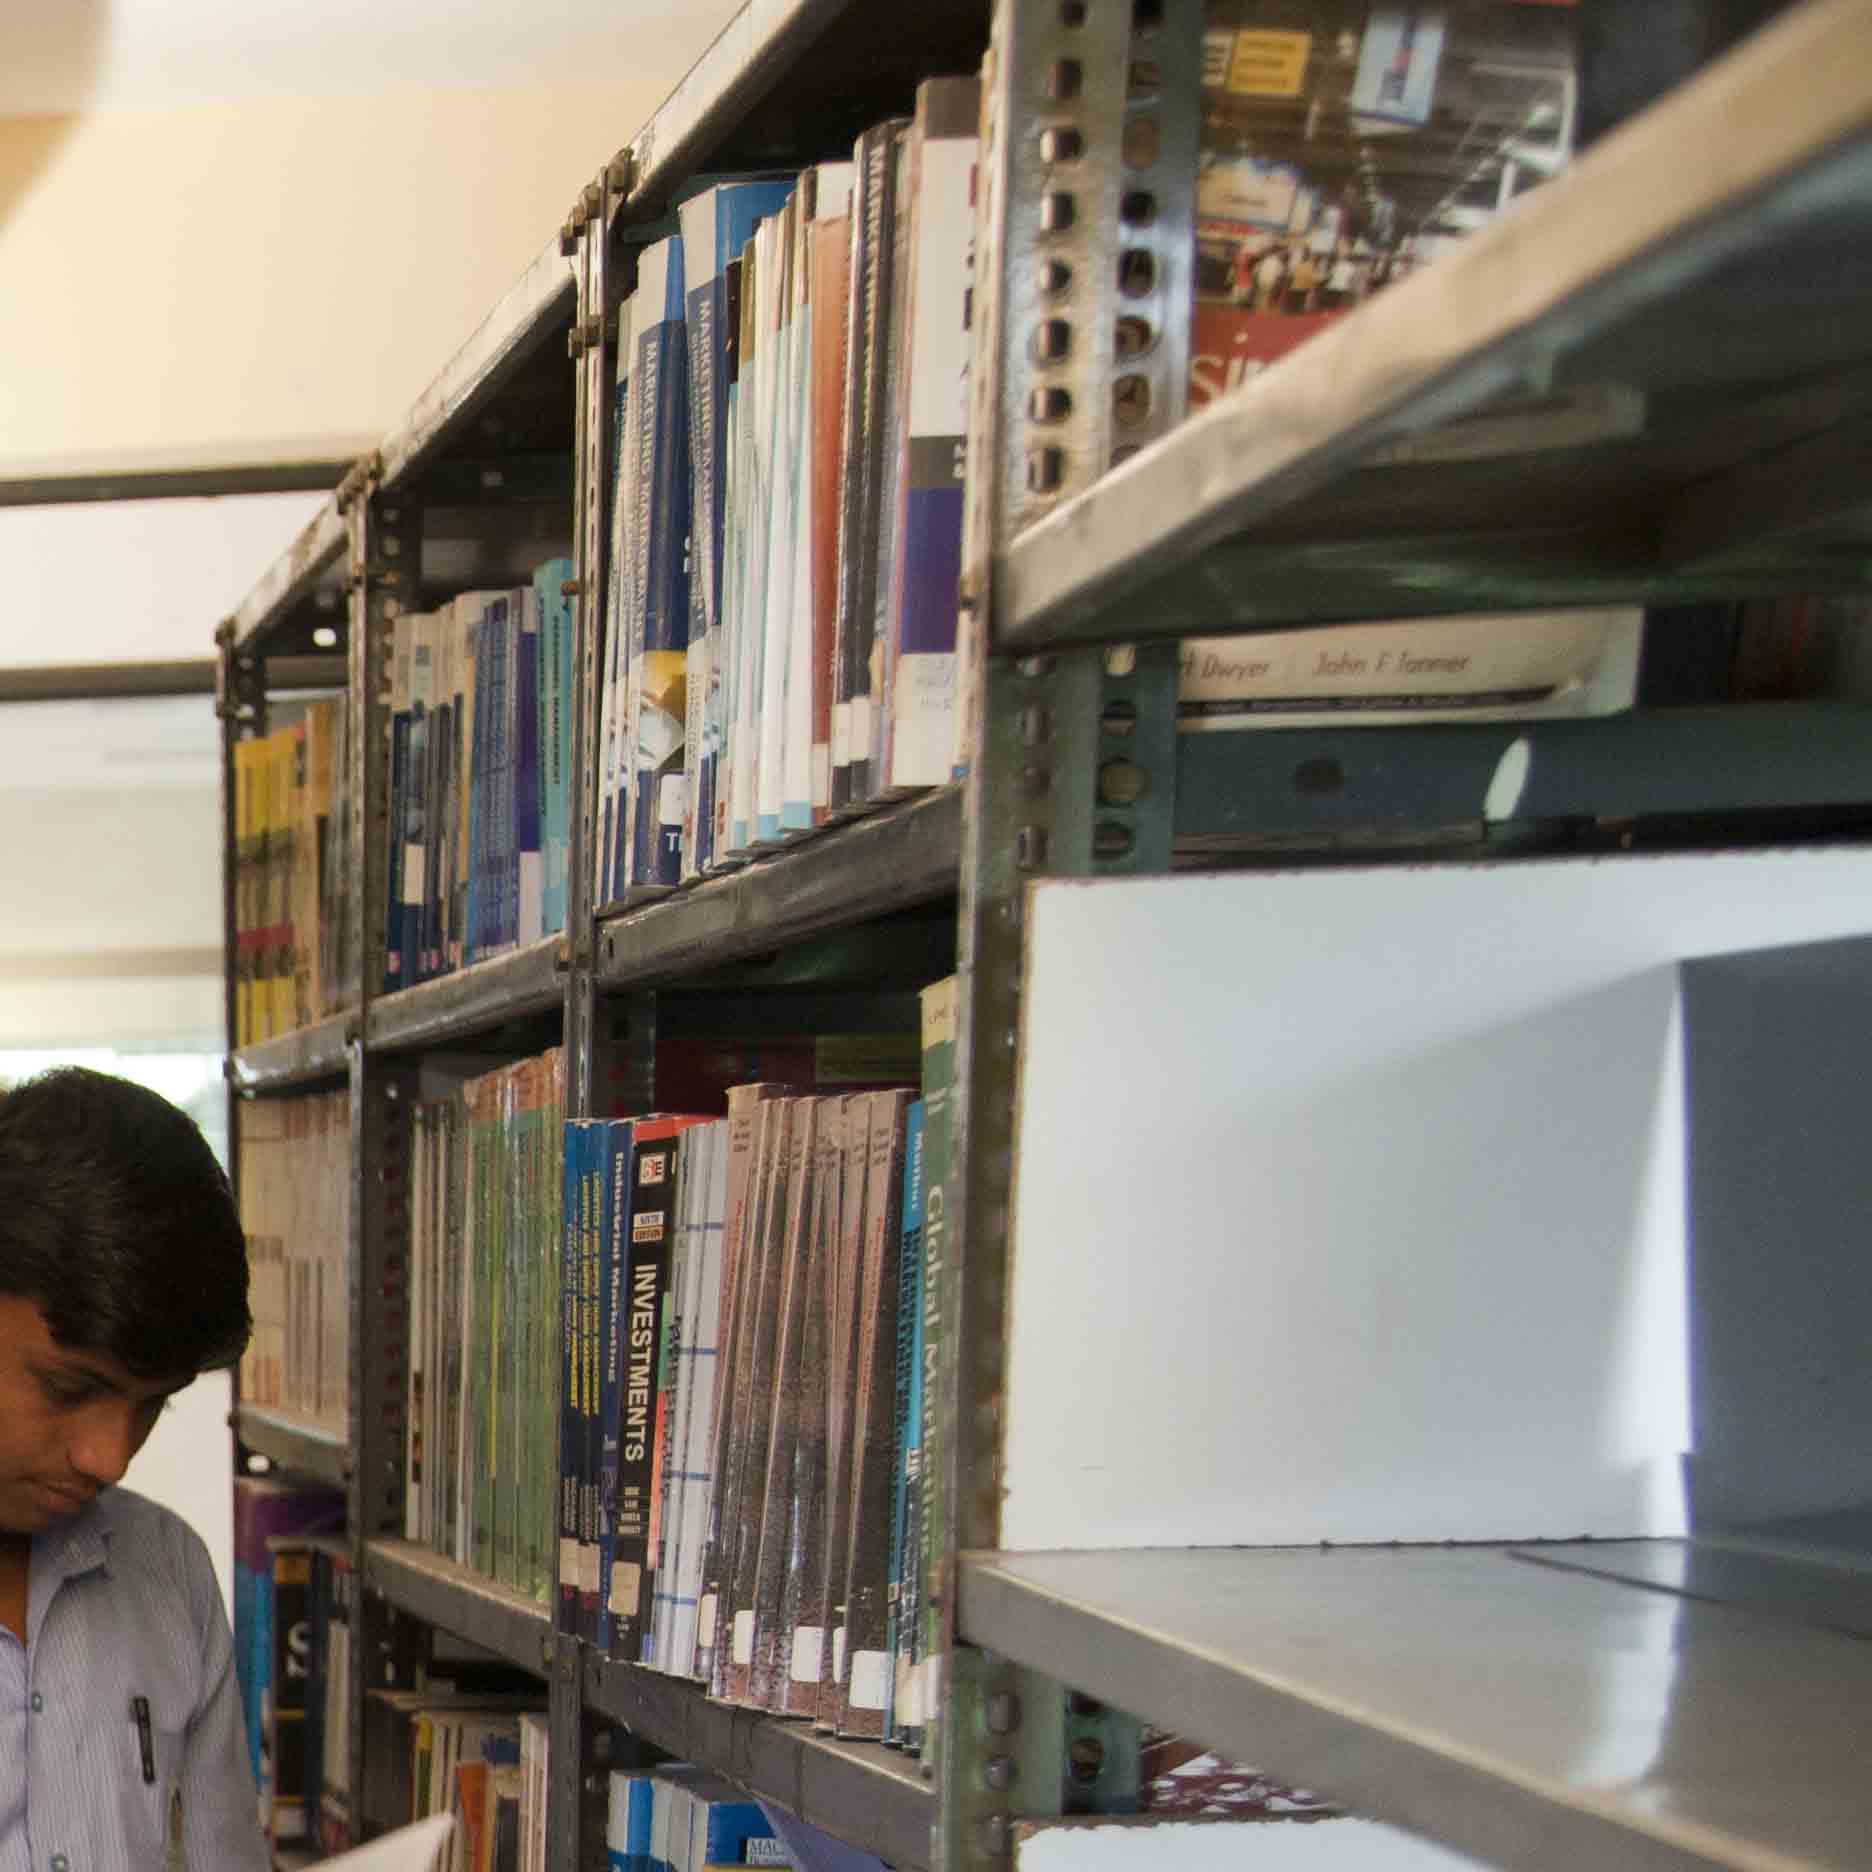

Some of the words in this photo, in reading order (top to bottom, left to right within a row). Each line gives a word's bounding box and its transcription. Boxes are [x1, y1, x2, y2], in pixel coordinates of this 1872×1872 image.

[639, 342, 661, 480] MARKETING
[699, 300, 715, 441] MARKETING
[632, 482, 653, 656] MANAGEMENT
[1200, 651, 1270, 682] Dwyer
[610, 1151, 623, 1261] Industrial
[924, 1185, 946, 1328] Global
[581, 1339, 591, 1417] MANAGEMENT
[592, 1336, 600, 1416] MANAGEMENT
[606, 1267, 621, 1384] Marketing
[625, 1262, 658, 1463] INVESTMENTS
[920, 1343, 940, 1559] Marketing
